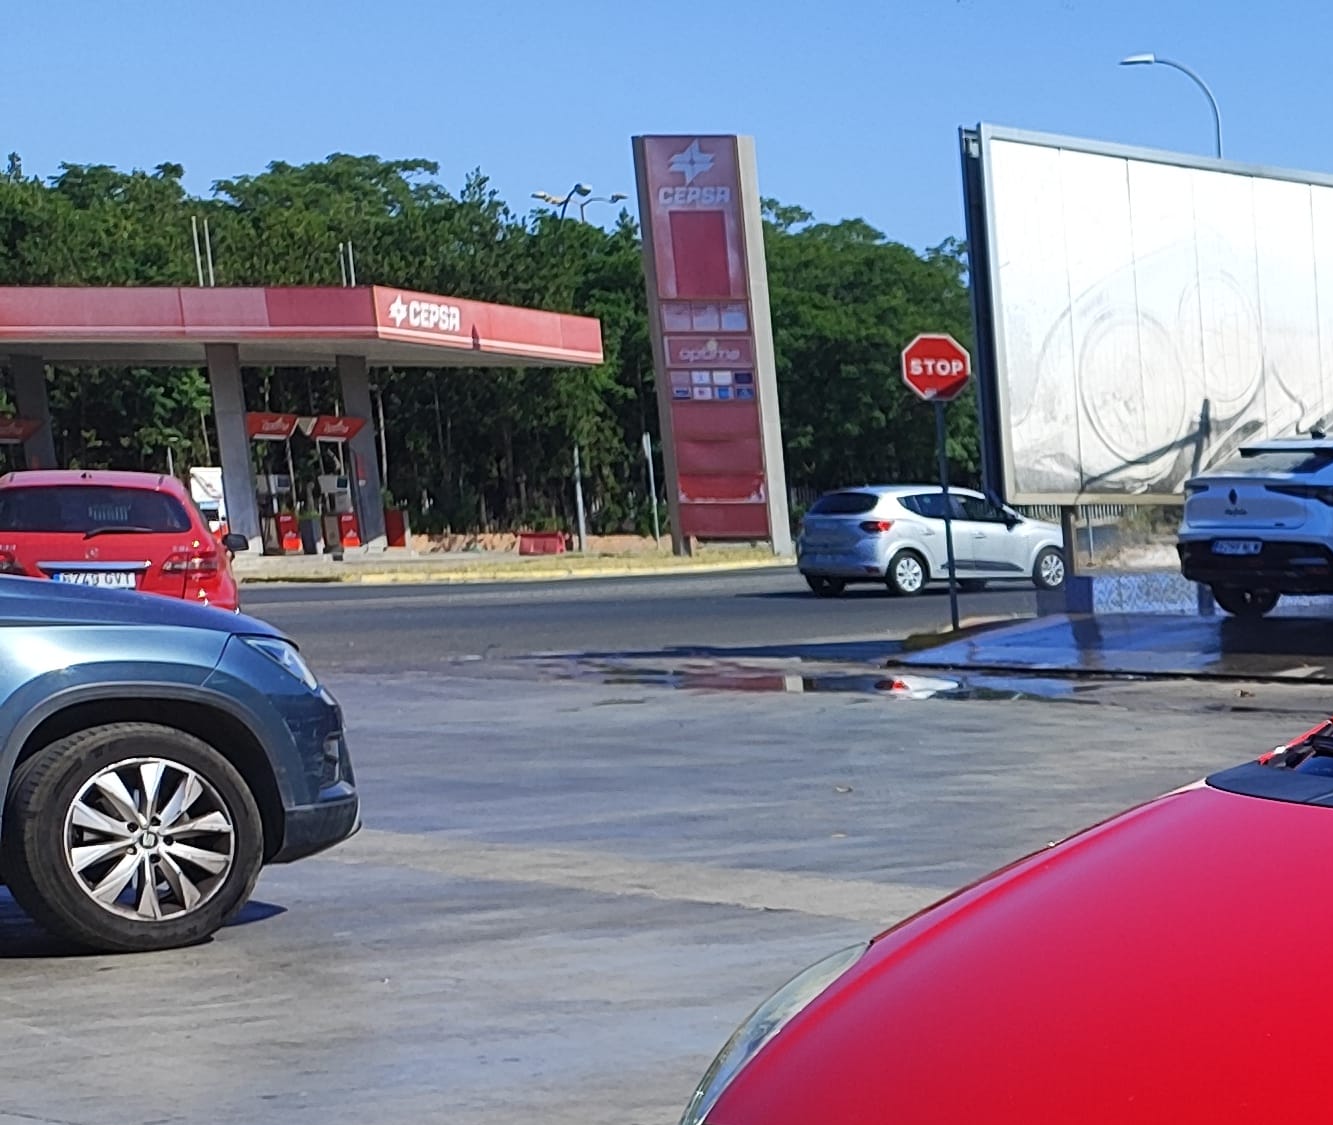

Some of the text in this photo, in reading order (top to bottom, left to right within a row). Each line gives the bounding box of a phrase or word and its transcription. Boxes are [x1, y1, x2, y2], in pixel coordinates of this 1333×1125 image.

[659, 187, 730, 205] CEPSA
[409, 300, 460, 332] CEPSA
[910, 357, 964, 376] STOP
